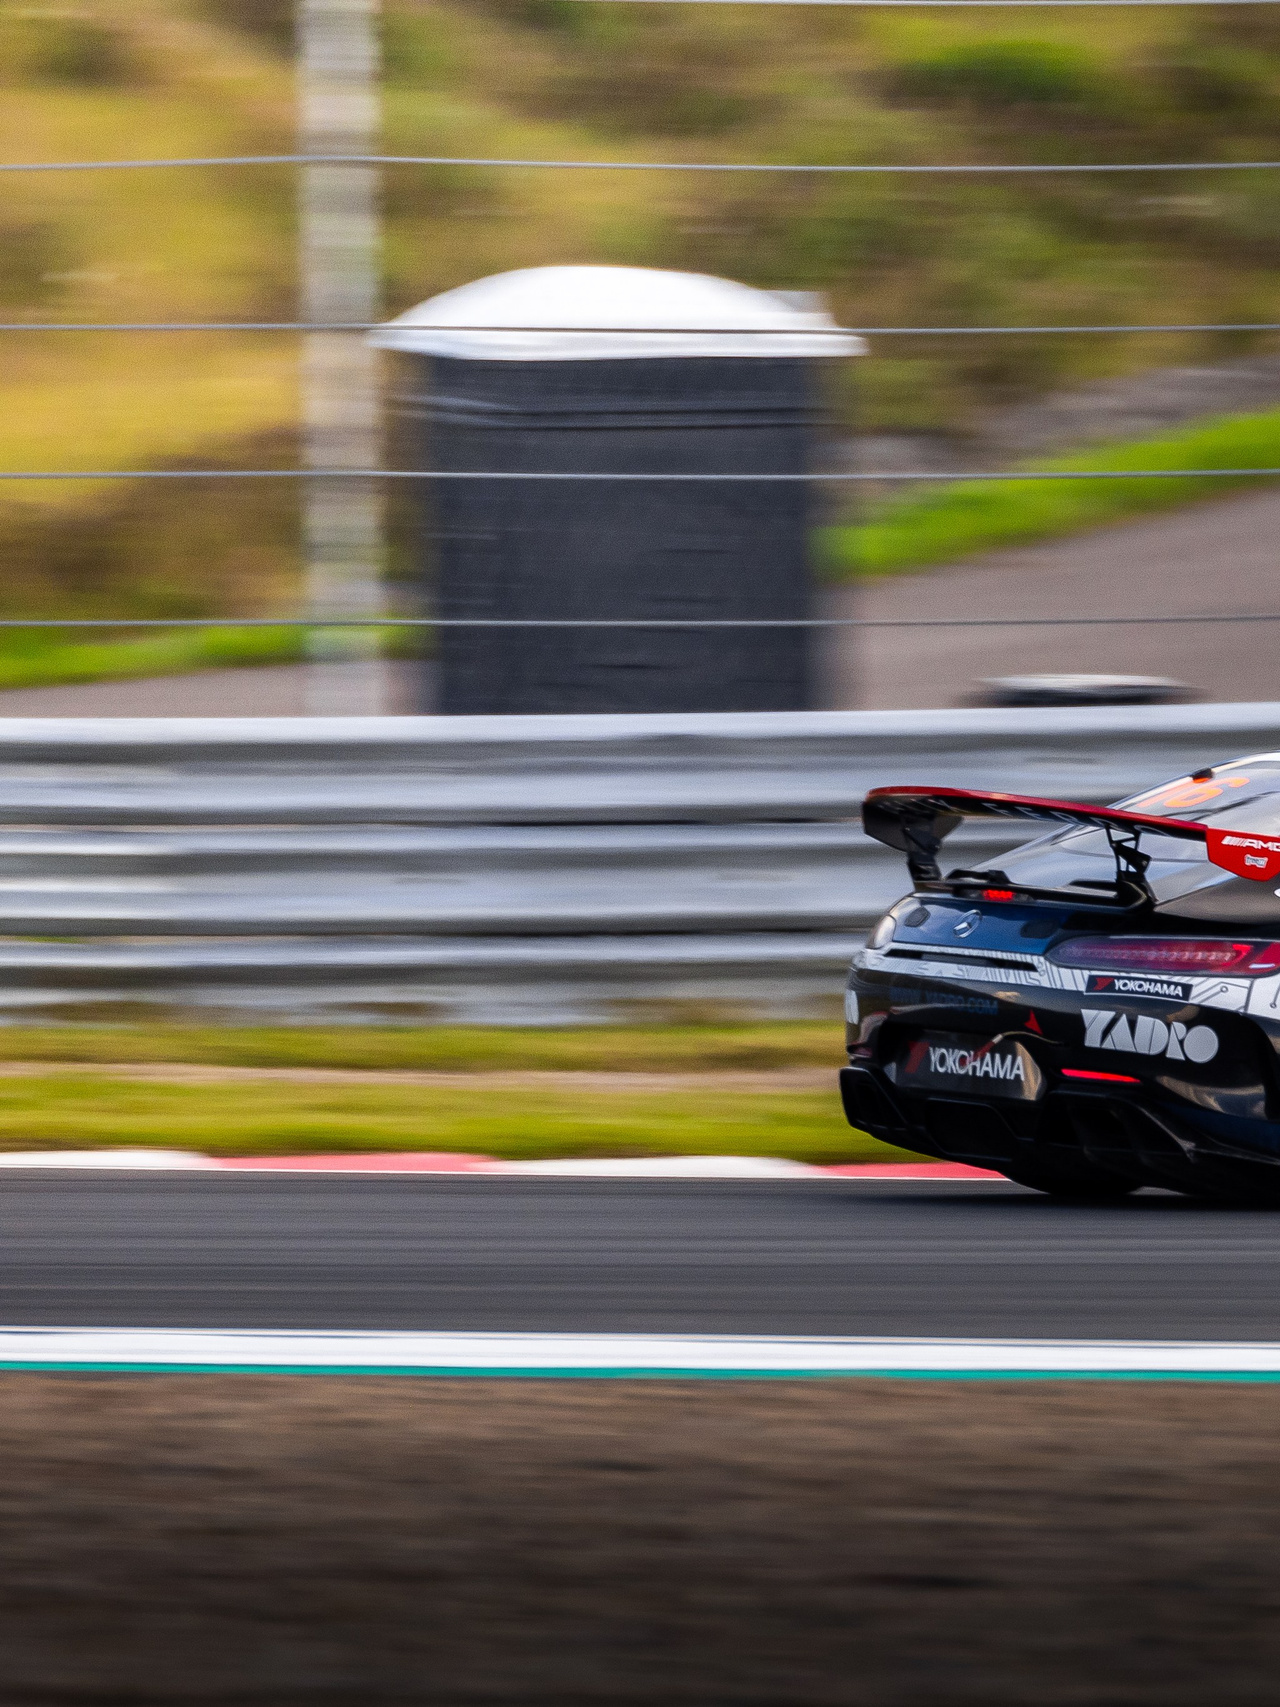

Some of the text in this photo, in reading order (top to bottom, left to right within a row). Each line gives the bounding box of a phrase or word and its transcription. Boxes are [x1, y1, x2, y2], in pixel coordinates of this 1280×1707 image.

[1113, 979, 1183, 998] YOKOHAMA
[1080, 1008, 1220, 1064] YADRO
[928, 1046, 1026, 1082] YOKOHAMA
